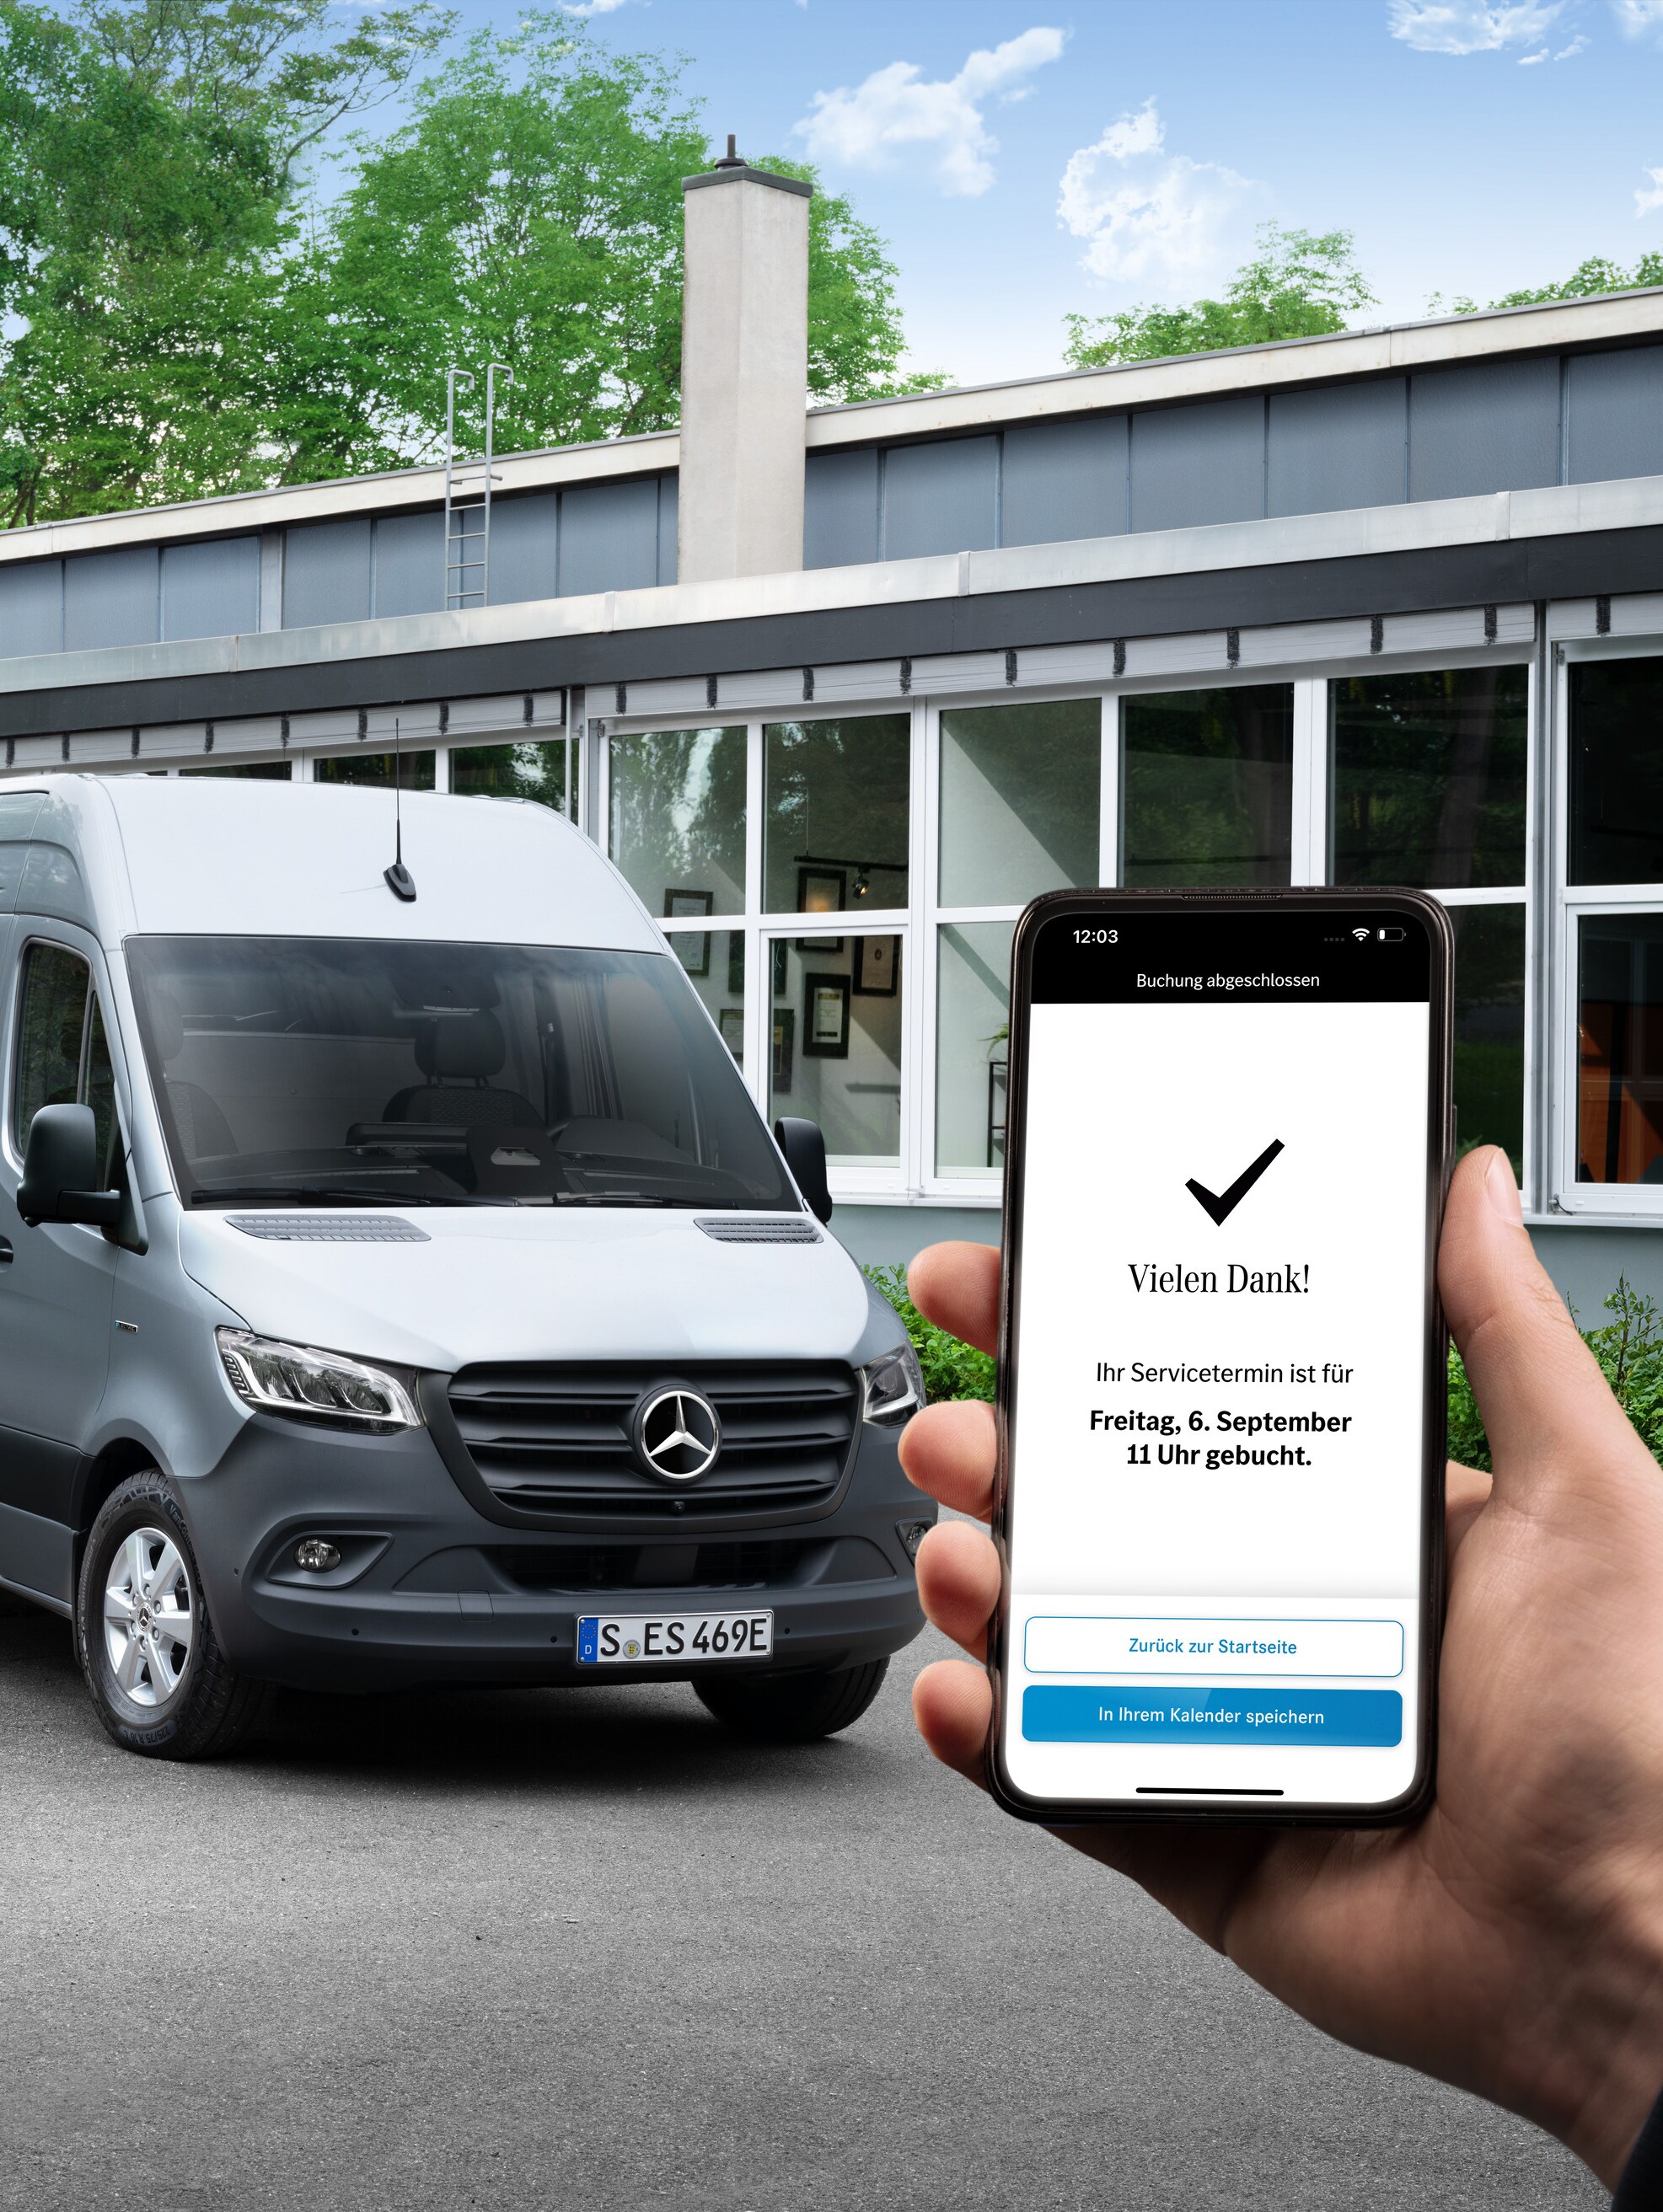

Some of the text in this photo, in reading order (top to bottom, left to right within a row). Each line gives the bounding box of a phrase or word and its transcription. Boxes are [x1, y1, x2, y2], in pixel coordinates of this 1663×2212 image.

[1073, 929, 1119, 944] 12:03
[1136, 972, 1320, 991] Buchung abgeschlossen
[1127, 1263, 1310, 1293] Vielen Dank!
[1097, 1362, 1355, 1384] Ihr Servicetermin ist für
[1090, 1409, 1353, 1437] Freitag, 6. September
[1127, 1443, 1312, 1470] 11 Uhr gebucht.
[600, 1618, 767, 1657] S ES 469E
[1129, 1637, 1297, 1655] Zurück zur Startseite
[584, 1644, 593, 1655] D
[1099, 1706, 1324, 1727] In Ihrem Kalender speichern
